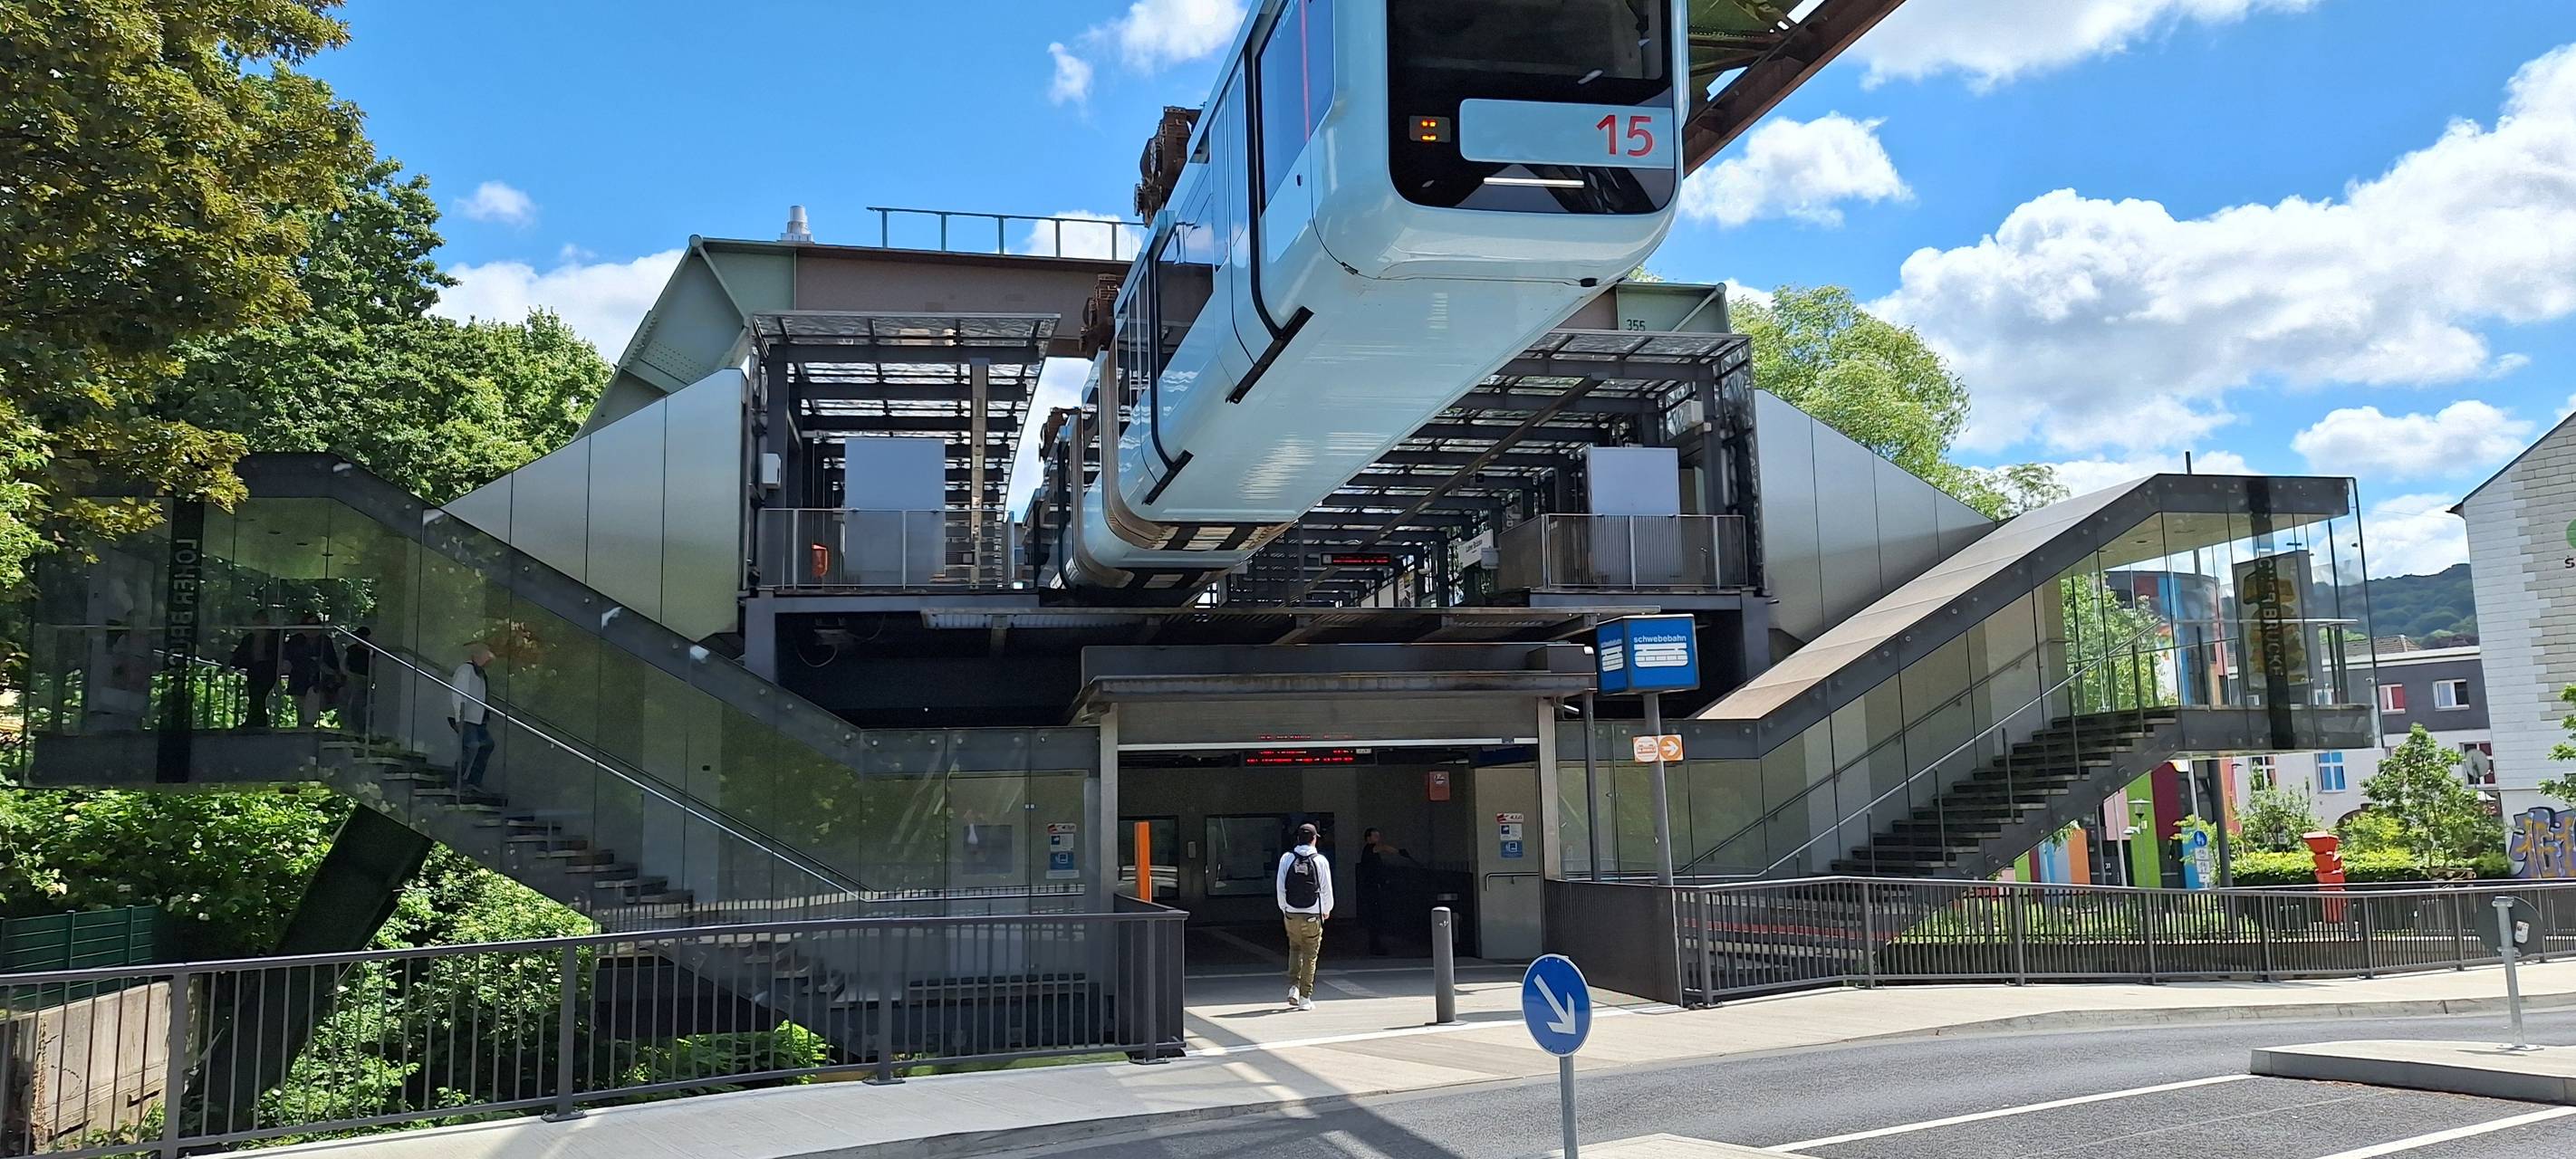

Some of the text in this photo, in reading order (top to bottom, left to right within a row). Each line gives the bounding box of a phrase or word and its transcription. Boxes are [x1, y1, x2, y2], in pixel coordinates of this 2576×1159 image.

[1596, 114, 1653, 157] 15
[1626, 319, 1646, 331] 355
[1633, 634, 1687, 643] schwebebahn
